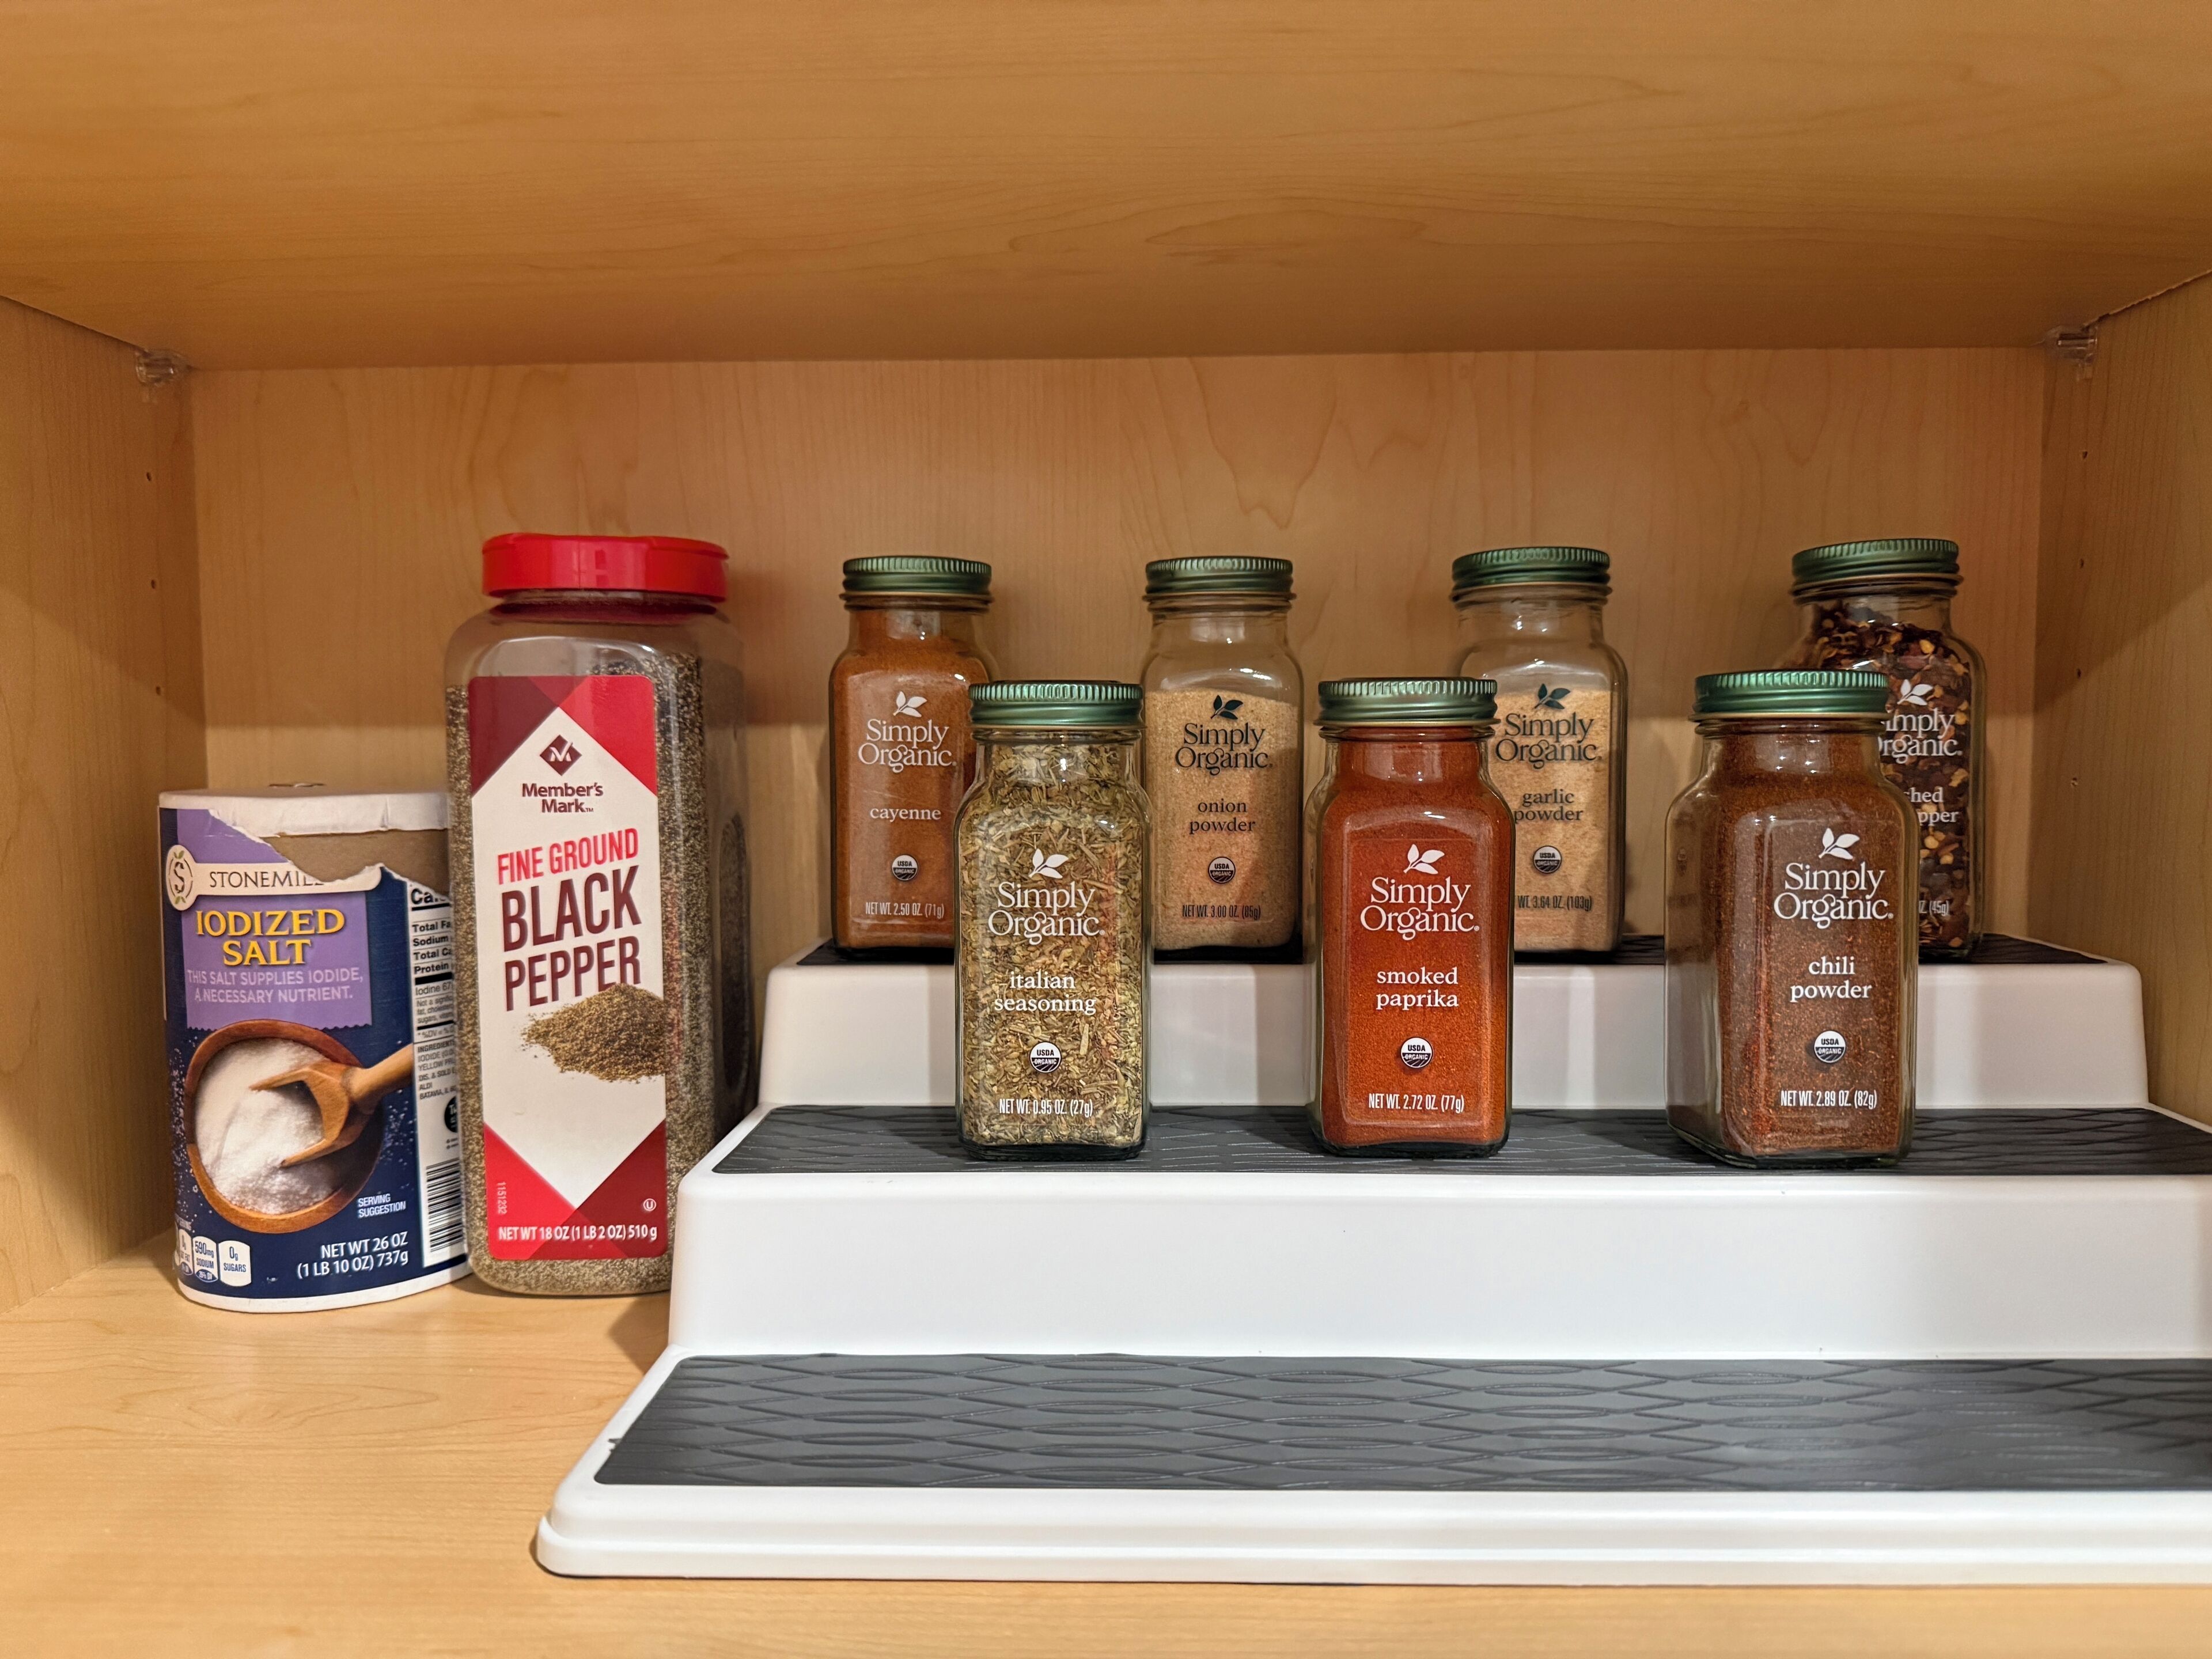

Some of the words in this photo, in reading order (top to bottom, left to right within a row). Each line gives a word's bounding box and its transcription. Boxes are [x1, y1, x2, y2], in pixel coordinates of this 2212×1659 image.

[866, 719, 949, 748] Simply
[1505, 711, 1594, 744] Simply
[1184, 722, 1266, 752] Simply
[1878, 734, 1959, 764] rganic
[521, 782, 604, 798] Member's
[1522, 789, 1575, 806] garlic
[1198, 798, 1247, 813] onion
[870, 808, 941, 823] cayenne
[1513, 806, 1583, 824] powder
[1917, 810, 1959, 826] pper
[1189, 817, 1256, 835] powder
[497, 847, 544, 885] FINE
[549, 828, 639, 874] GROUND
[210, 870, 324, 888] STONEMIL
[1785, 862, 1886, 900] Simply
[998, 881, 1095, 916] Simply
[1370, 876, 1471, 911] Simply
[501, 865, 642, 952] BLACK
[865, 902, 878, 915] NET
[879, 902, 891, 915] WT.
[893, 902, 910, 915] 2.50
[912, 903, 923, 916] OZ.
[925, 903, 945, 919] (71g)
[1182, 904, 1195, 918] NET
[1196, 904, 1209, 918] WT.
[1211, 905, 1226, 918] 3.00
[1229, 905, 1239, 918] OZ.
[1242, 904, 1261, 920] (85g)
[1533, 895, 1550, 908] 3.64
[1567, 895, 1592, 911] (103g)
[1929, 900, 1949, 916] (45g)
[196, 908, 344, 937] IODIZED
[412, 922, 438, 933] Total
[413, 935, 448, 946] Sodium
[223, 939, 311, 966] SALT
[414, 950, 440, 960] Total
[414, 963, 449, 974] Protein
[505, 935, 642, 1012] PEPPER
[1808, 956, 1855, 975] chili
[188, 969, 207, 984] THIS
[210, 971, 236, 985] SALT
[240, 971, 304, 986] SUPPLIES
[309, 967, 363, 983] IODIDE,
[1009, 971, 1075, 989] italian
[1377, 967, 1459, 985] smoked
[195, 987, 202, 1001] A
[203, 988, 274, 1003] NECESSARY
[278, 986, 353, 1002] NUTRIENT.
[415, 985, 441, 995] Iodine
[1790, 979, 1873, 1003] powder
[994, 994, 1097, 1015] seasoning
[1376, 990, 1459, 1011] paprika
[999, 1099, 1014, 1114] NET
[1016, 1099, 1030, 1114] WT.
[1033, 1099, 1052, 1115] 0.95
[1055, 1099, 1067, 1115] OZ.
[1070, 1099, 1093, 1118] (27g)
[1369, 1093, 1384, 1109] NET
[1386, 1093, 1400, 1109] WT.
[1403, 1094, 1422, 1109] 2.72
[1425, 1094, 1438, 1110] OZ.
[1441, 1094, 1465, 1113] (77g)
[1781, 1090, 1797, 1107] NET
[1798, 1090, 1813, 1107] WT.
[1816, 1090, 1836, 1107] 2.89
[1838, 1090, 1851, 1107] OZ.
[1854, 1090, 1878, 1109] (82g)
[358, 1194, 391, 1207] SERVING
[497, 1181, 507, 1215] 1151232
[358, 1201, 406, 1218] SUGGESTION
[499, 1226, 520, 1240] NET
[520, 1226, 538, 1240] WT
[540, 1226, 552, 1240] 18
[554, 1226, 570, 1240] OZ
[571, 1225, 580, 1241] (1
[584, 1225, 596, 1239] LB
[600, 1225, 605, 1239] 2
[607, 1225, 626, 1240] OZ)
[629, 1225, 648, 1238] 510
[650, 1226, 657, 1240] g
[195, 1241, 214, 1258] 590mg
[229, 1247, 238, 1261] 0g
[321, 1243, 346, 1259] NET
[348, 1239, 370, 1255] WT
[373, 1236, 389, 1252] 26
[391, 1232, 408, 1247] OZ
[196, 1257, 214, 1268] SODIUM
[224, 1263, 247, 1272] SUGARS
[297, 1263, 309, 1279] (1
[314, 1262, 330, 1276] LB
[333, 1260, 349, 1274] 10
[351, 1255, 374, 1271] OZ)
[377, 1250, 408, 1267] 737g
